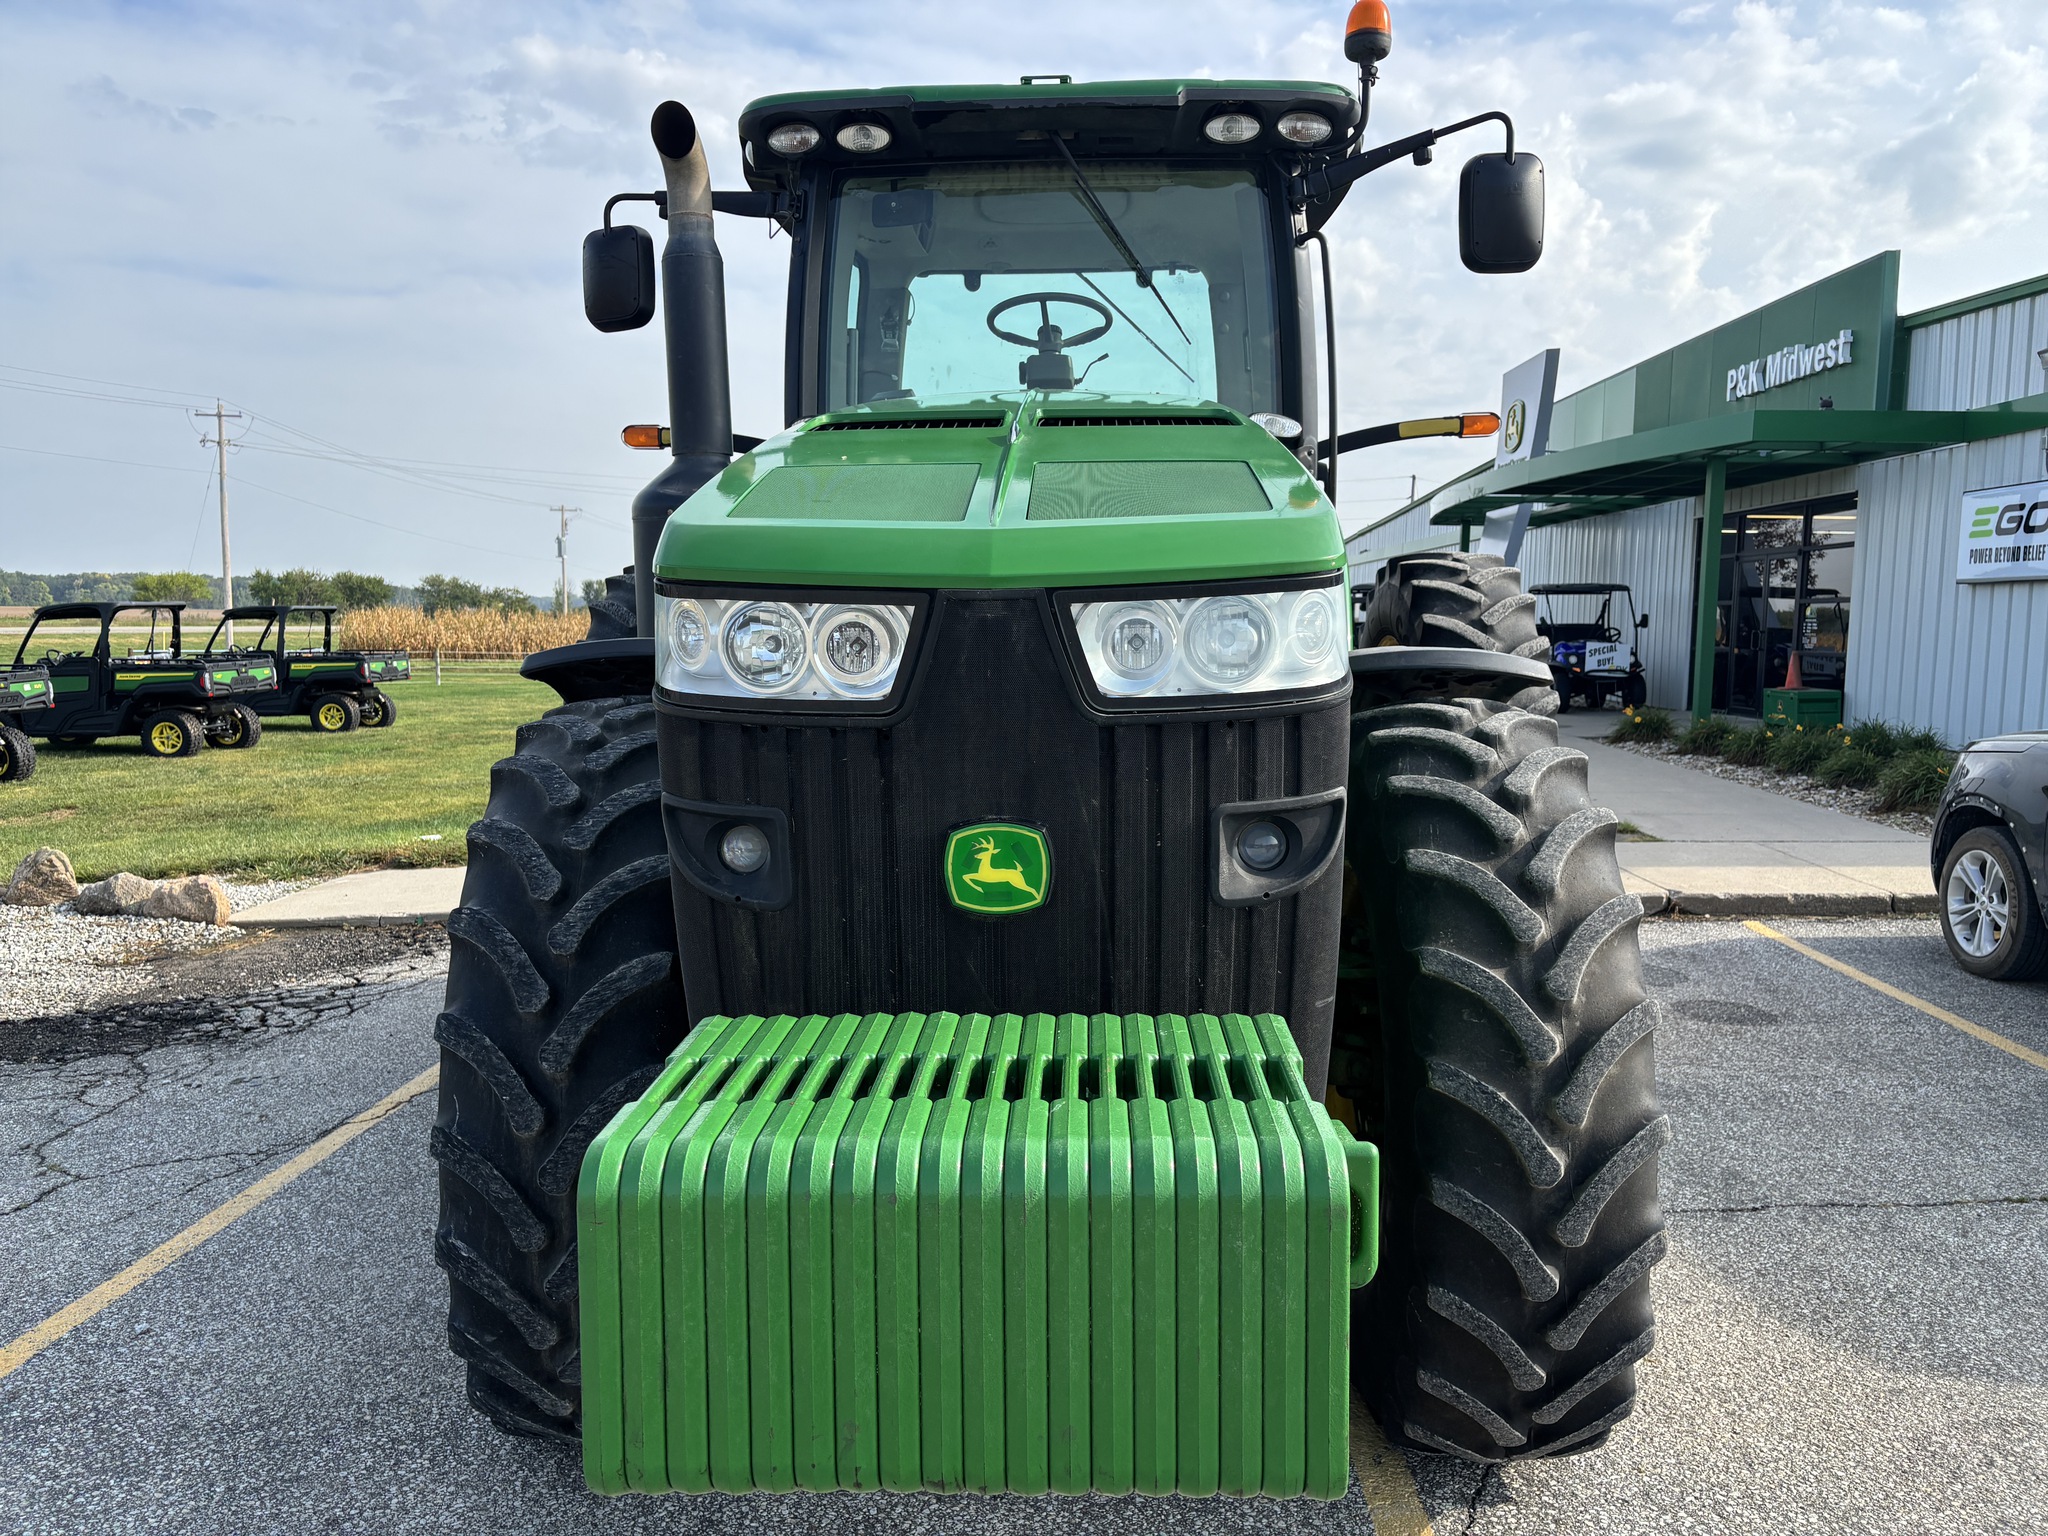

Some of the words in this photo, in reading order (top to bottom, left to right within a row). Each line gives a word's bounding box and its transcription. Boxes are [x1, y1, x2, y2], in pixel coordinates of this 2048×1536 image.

[1726, 359, 1765, 402] P&K
[1765, 329, 1853, 389] Midwest
[1969, 501, 2048, 539] EGO
[1969, 548, 1993, 565] POWER
[1994, 545, 2021, 563] BEYOND
[2022, 543, 2046, 562] BELIEF
[1588, 644, 1618, 658] SPECIAL
[1597, 656, 1614, 667] BUY!
